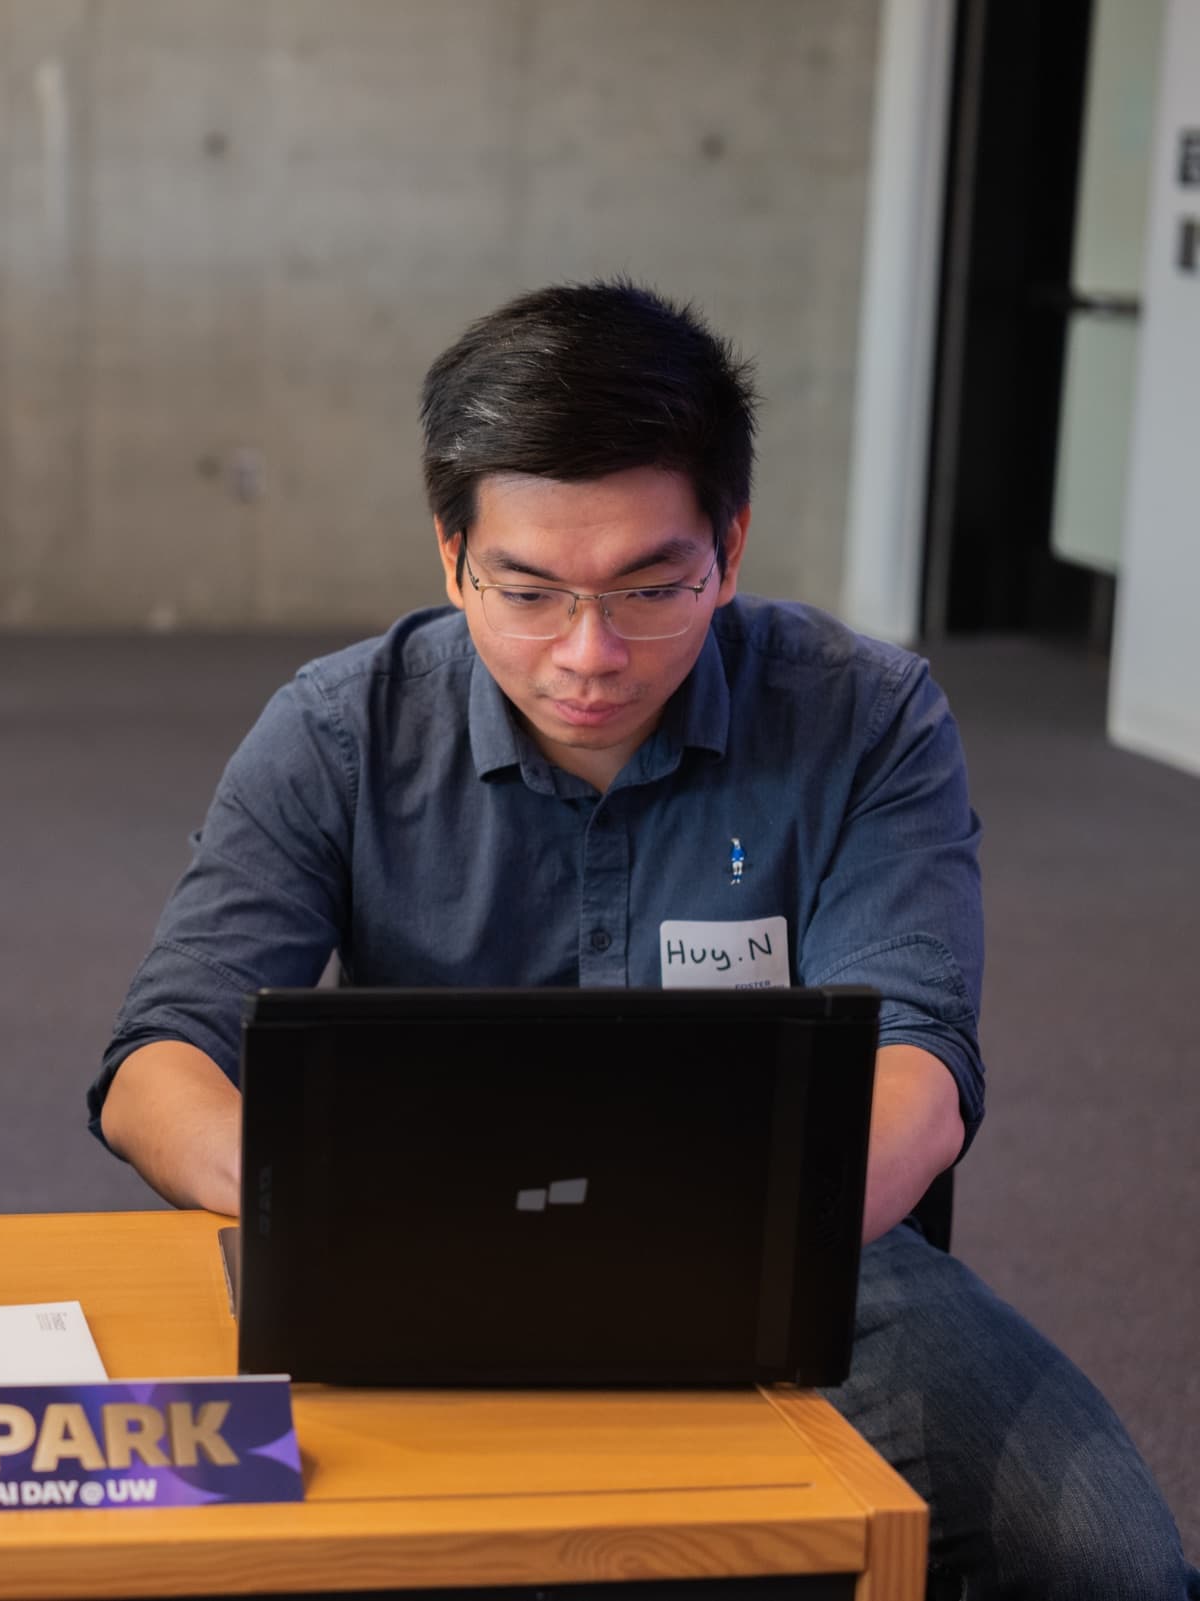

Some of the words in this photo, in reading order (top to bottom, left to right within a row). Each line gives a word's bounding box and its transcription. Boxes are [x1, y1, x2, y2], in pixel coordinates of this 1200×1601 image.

[20, 1479, 79, 1506] DAY
[79, 1481, 105, 1506] @
[105, 1477, 158, 1502] UW
